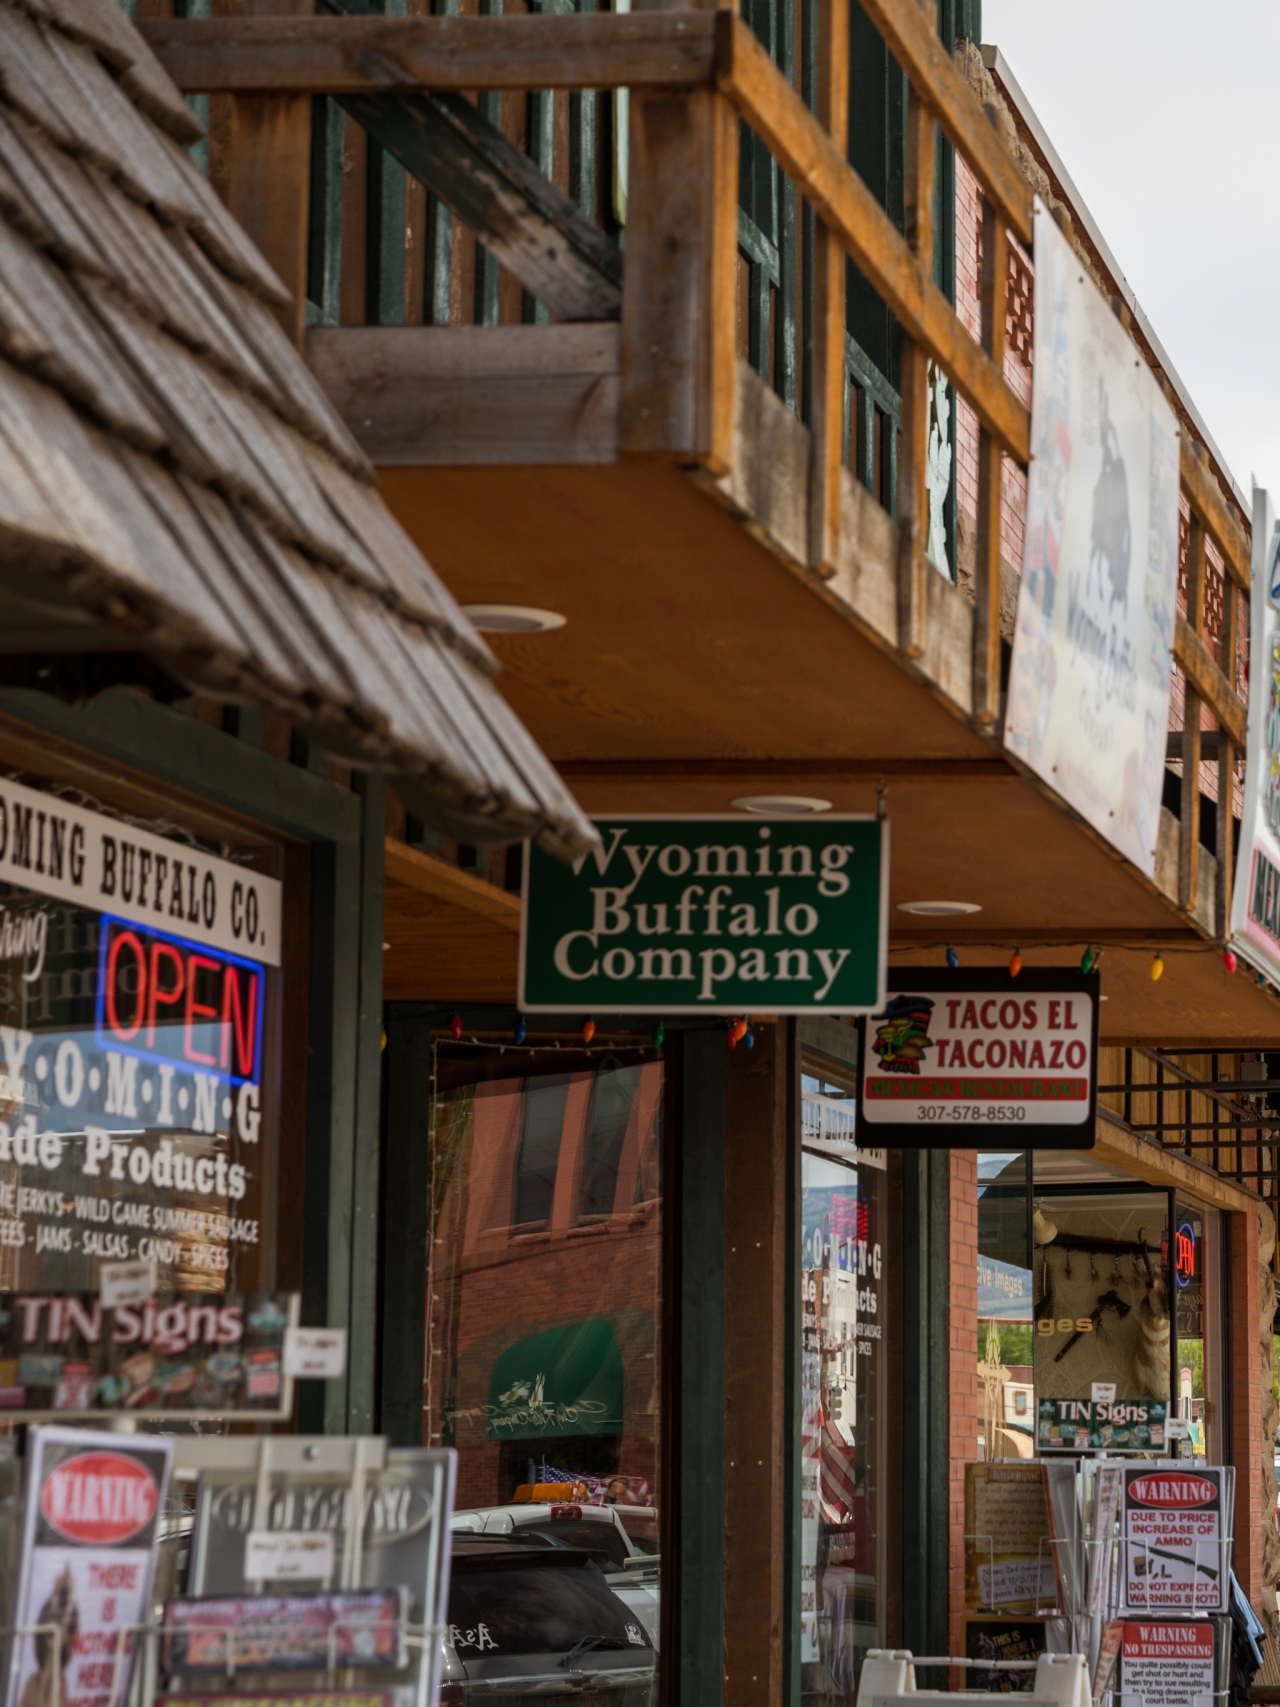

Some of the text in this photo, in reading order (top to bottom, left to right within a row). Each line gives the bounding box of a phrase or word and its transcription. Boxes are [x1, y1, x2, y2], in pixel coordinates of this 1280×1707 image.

[100, 834, 217, 930] BUFFALO
[230, 880, 266, 947] CO.
[590, 886, 818, 936] Buffalo
[553, 930, 851, 1001] Company
[106, 931, 259, 1076] OPEN
[946, 1000, 1078, 1029] TACOS EL
[935, 1039, 1087, 1069] TACONAZO
[870, 1079, 1084, 1099] MEXICAN RESTAURANT
[917, 1106, 1026, 1122] 307-578-8530
[83, 1125, 248, 1200] Products
[17, 1186, 65, 1218] JERKYS
[75, 1196, 110, 1223] WILD
[112, 1201, 152, 1229] GAME
[152, 1207, 206, 1238] SUMMER
[207, 1214, 260, 1244] SAUSAGE
[36, 1226, 73, 1254] JAMS
[82, 1231, 129, 1259] SALSAS
[138, 1238, 184, 1265] CANDY
[190, 1244, 230, 1271] SPICES
[995, 1265, 1023, 1299] Images
[15, 1298, 102, 1343] TIN
[111, 1298, 244, 1355] Signs
[1038, 1317, 1093, 1337] ges
[1057, 1401, 1148, 1426] TIN Signs
[49, 1469, 155, 1524] WARNING
[1134, 1481, 1211, 1500] WARNING
[1131, 1512, 1215, 1523] DUE TO PRICE
[1132, 1524, 1214, 1534] INCREASE OF
[1154, 1537, 1193, 1547] AMMO
[1129, 1582, 1219, 1592] DO NOT EXPECT A
[1129, 1594, 1218, 1604] WARNING SHOT!
[1139, 1627, 1196, 1643] WARNING
[1124, 1643, 1211, 1656] NO TRESPASSING
[1132, 1671, 1143, 1679] get
[1139, 1660, 1158, 1669] quite
[1160, 1661, 1188, 1670] possibly
[1147, 1688, 1161, 1696] long
[1178, 1680, 1211, 1688] resulting
[1167, 1697, 1189, 1705] battle.
